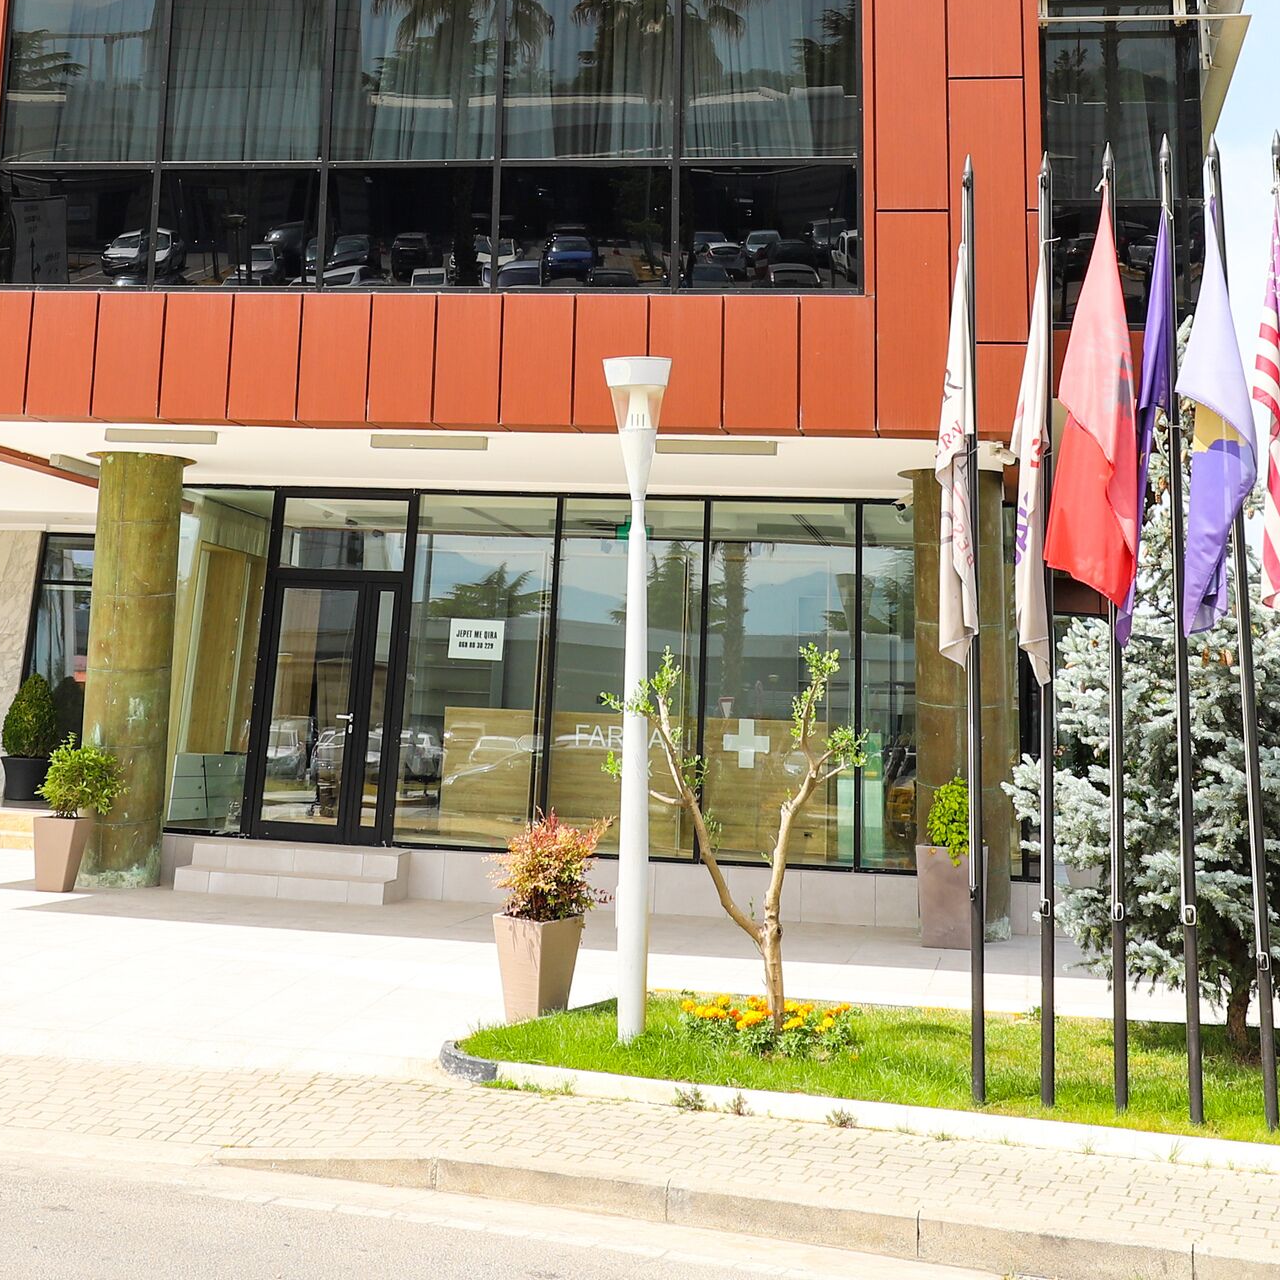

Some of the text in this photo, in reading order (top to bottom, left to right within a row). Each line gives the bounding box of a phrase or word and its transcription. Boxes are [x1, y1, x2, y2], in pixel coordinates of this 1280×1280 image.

[456, 629, 498, 640] JEPET ME QIRA
